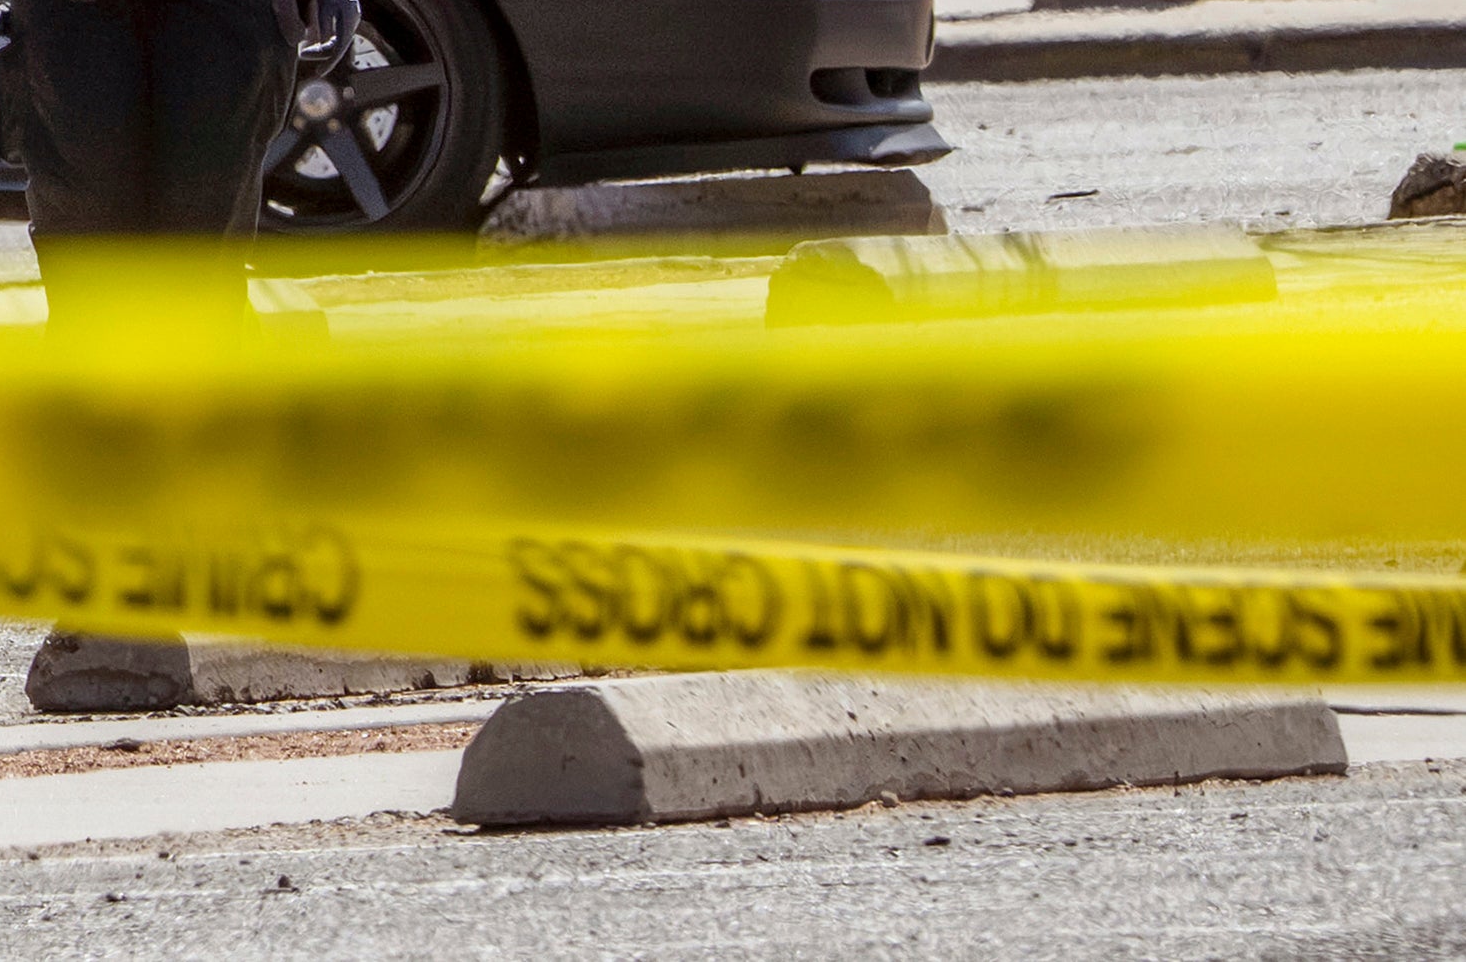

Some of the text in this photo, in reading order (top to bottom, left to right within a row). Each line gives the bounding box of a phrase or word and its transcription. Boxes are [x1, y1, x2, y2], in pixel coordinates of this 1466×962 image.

[509, 536, 787, 646] CROSS
[806, 553, 952, 654] NOT
[970, 566, 1080, 662] DO
[1091, 576, 1340, 671] SCENE
